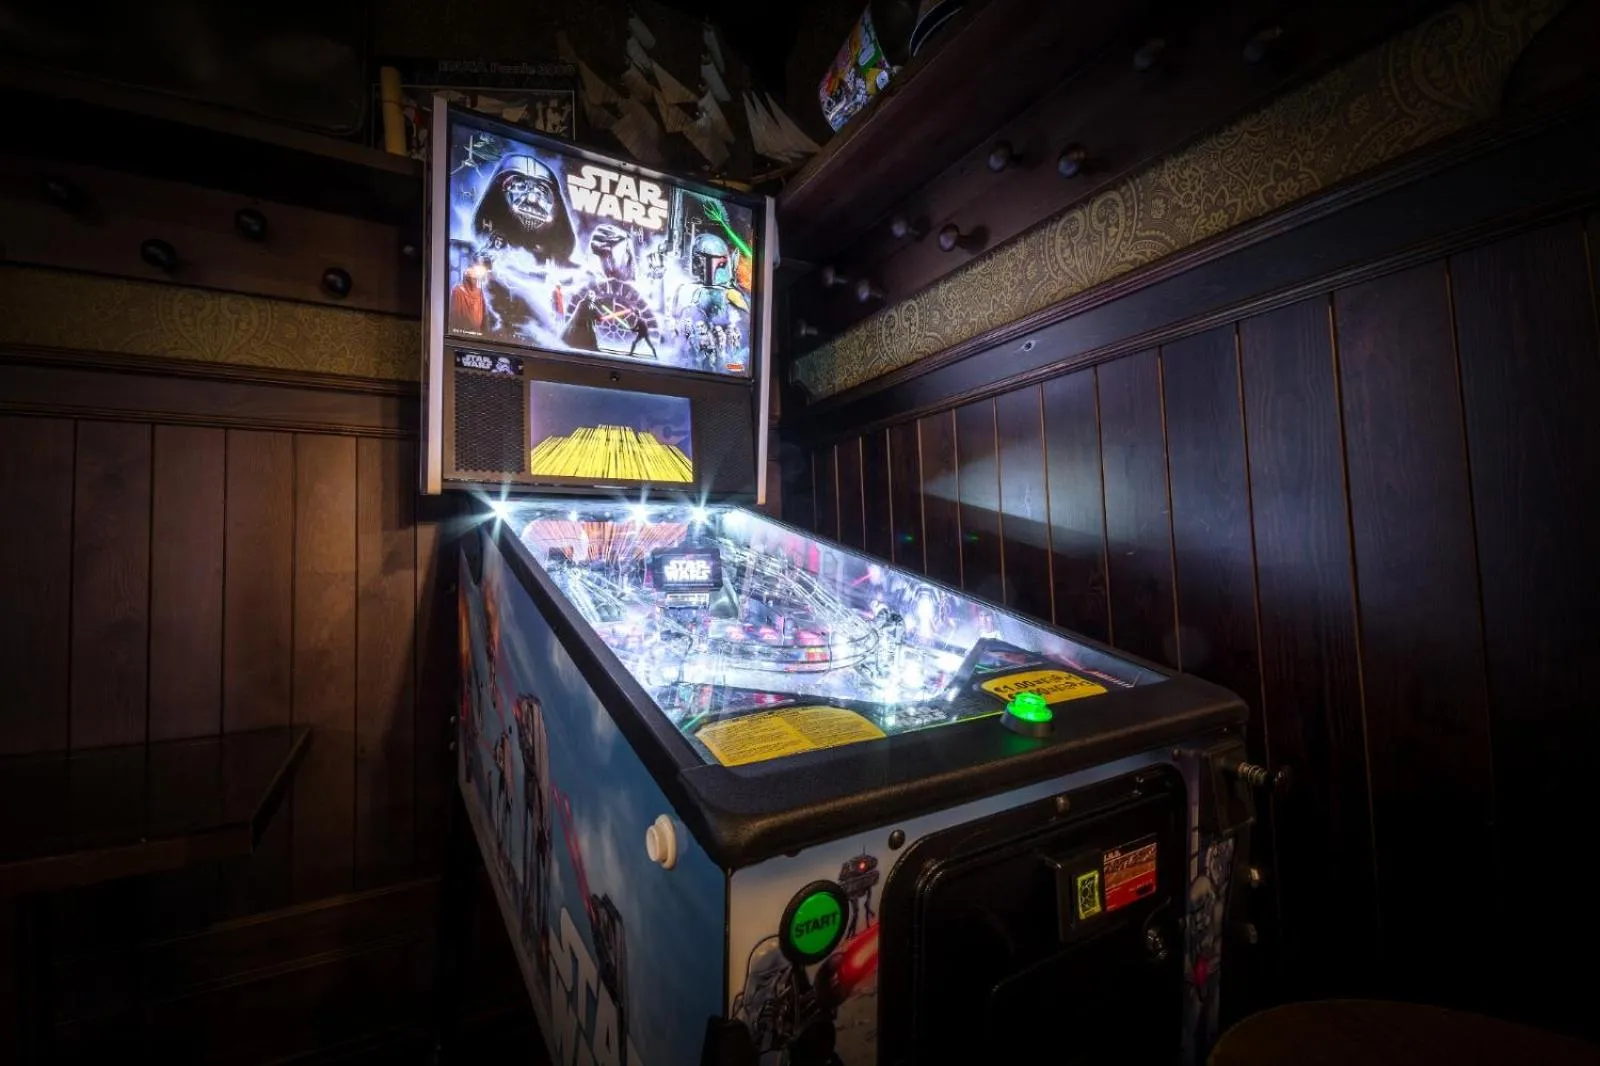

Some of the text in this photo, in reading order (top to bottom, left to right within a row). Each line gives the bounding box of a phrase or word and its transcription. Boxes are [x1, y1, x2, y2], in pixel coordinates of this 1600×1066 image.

[567, 164, 669, 210] STAR
[567, 182, 669, 230] WARS
[461, 353, 493, 364] STAR
[462, 359, 493, 370] WARS
[663, 559, 713, 577] STAR
[664, 572, 712, 590] WARS
[794, 910, 840, 940] START
